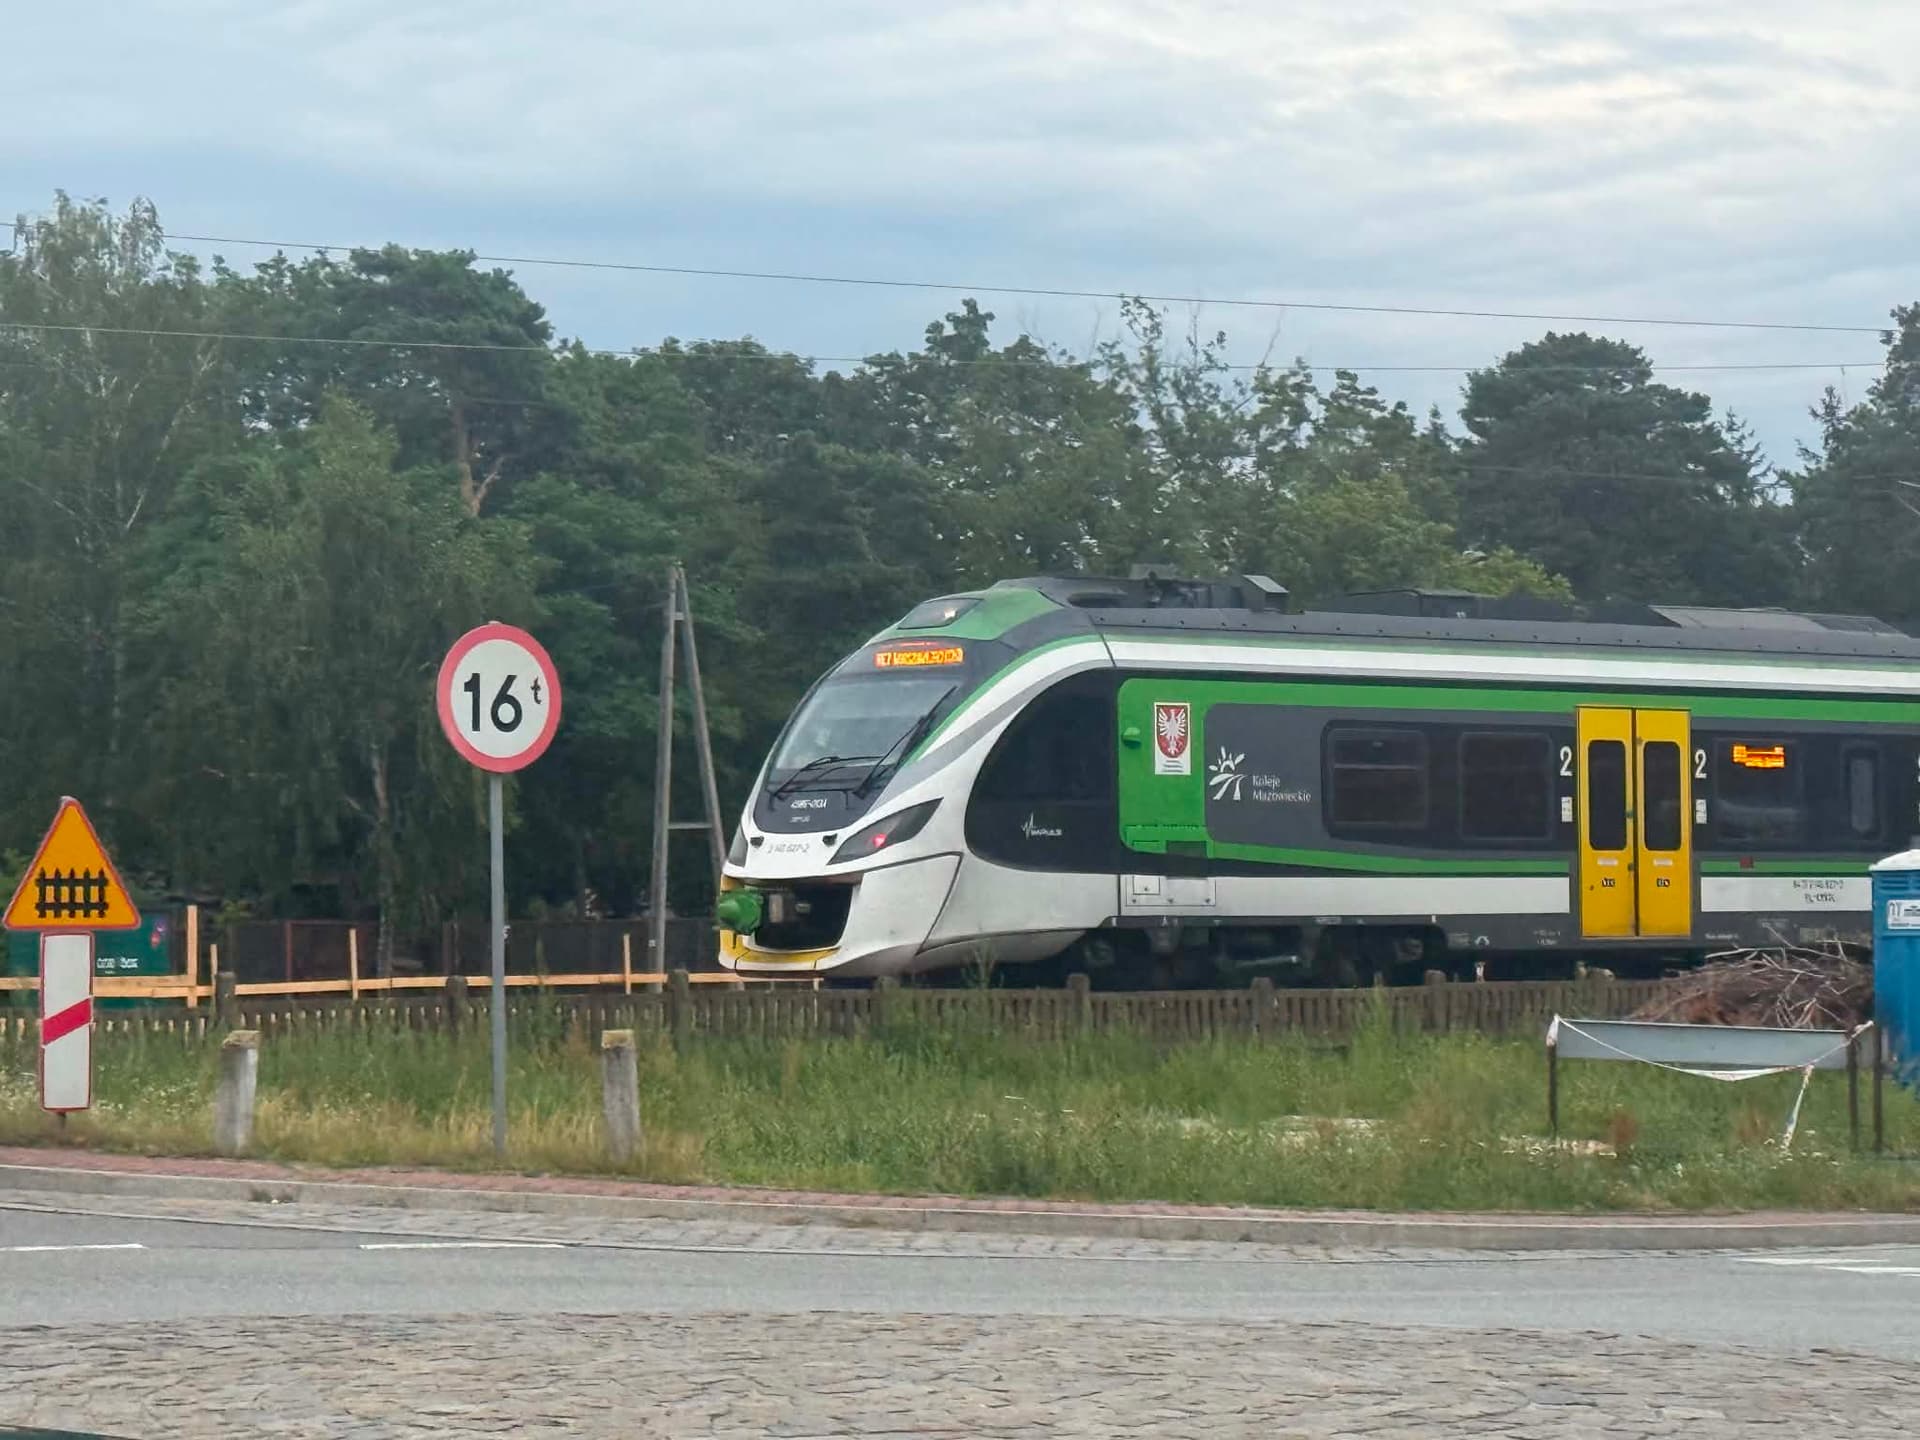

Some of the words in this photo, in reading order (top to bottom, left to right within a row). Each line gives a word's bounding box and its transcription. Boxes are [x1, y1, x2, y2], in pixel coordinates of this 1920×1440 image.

[463, 672, 523, 733] 16
[1559, 746, 1573, 777] 2
[1694, 749, 1708, 779] 2
[1252, 775, 1281, 790] Koleje
